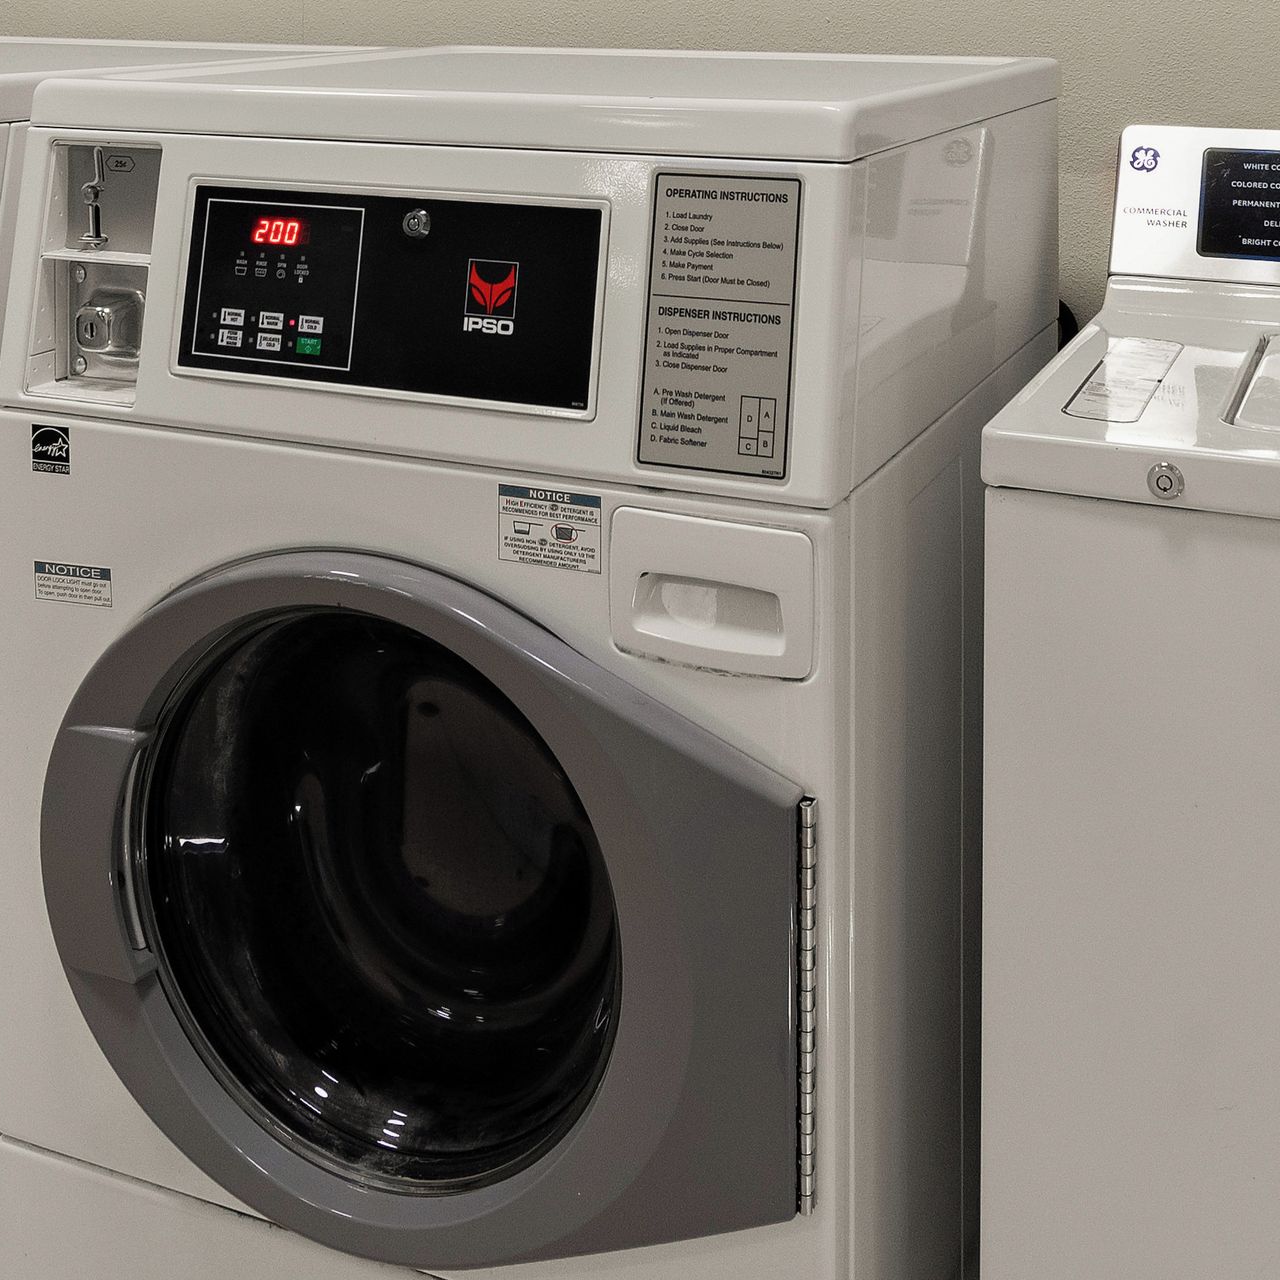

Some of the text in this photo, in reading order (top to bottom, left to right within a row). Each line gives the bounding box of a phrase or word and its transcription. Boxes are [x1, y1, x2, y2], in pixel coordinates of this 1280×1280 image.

[666, 189, 788, 203] OPERATING INSTRUCTIONS
[1233, 200, 1280, 208] PERMANENT
[689, 213, 712, 221] Laundry
[1124, 207, 1187, 217] COMMERCIAL
[1147, 220, 1187, 228] WASHER
[255, 220, 298, 243] 200
[684, 237, 709, 245] Supplies
[727, 240, 760, 248] Instructions
[762, 242, 783, 251] Below)
[1242, 238, 1272, 246] BRIGHT
[688, 250, 704, 258] Cycle
[706, 251, 733, 259] Selection
[687, 263, 713, 271] Payment
[702, 276, 719, 284] (Door
[747, 279, 770, 288] Closed)
[658, 307, 781, 325] DISPENSER INSTRUCTIONS
[463, 317, 514, 335] IPSO
[665, 328, 681, 336] Open
[683, 329, 712, 338] Dispenser
[672, 351, 698, 359] Indicated
[680, 343, 705, 352] Supplies
[714, 346, 734, 354] Proper
[736, 347, 777, 357] Compartment
[681, 363, 711, 371] Dispenser
[713, 365, 727, 373] Door
[694, 392, 725, 402] Detergent
[669, 399, 694, 408] Offered)
[697, 414, 728, 424] Detergent
[660, 423, 679, 432] Liquid
[680, 425, 702, 433] Bleach
[659, 436, 678, 444] Fabric
[680, 437, 707, 447] Softener
[32, 444, 61, 456] energy
[33, 463, 69, 473] ENERGY STAR
[529, 490, 571, 502] NOTICE
[46, 564, 101, 578] NOTICE
